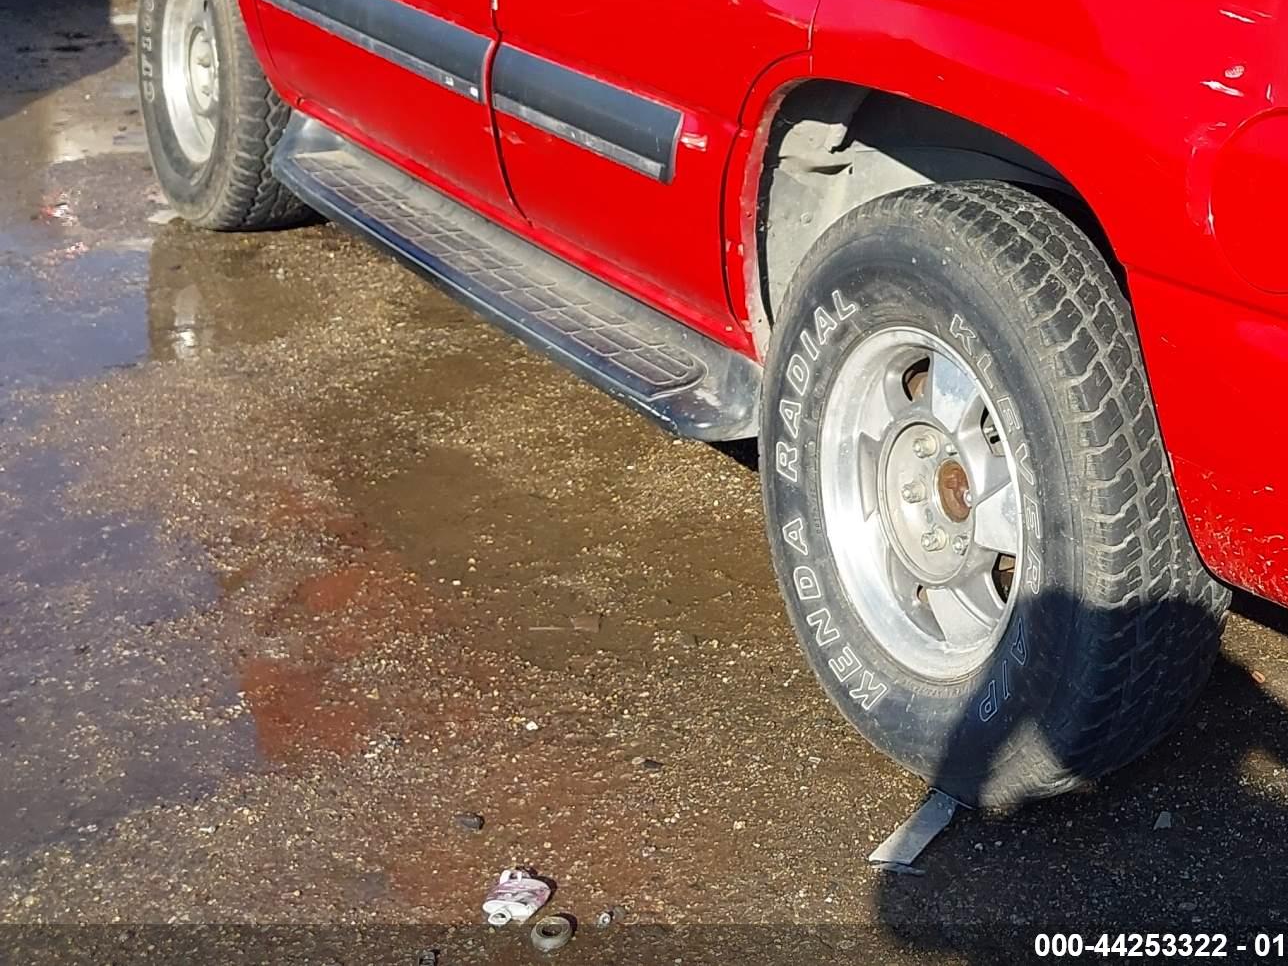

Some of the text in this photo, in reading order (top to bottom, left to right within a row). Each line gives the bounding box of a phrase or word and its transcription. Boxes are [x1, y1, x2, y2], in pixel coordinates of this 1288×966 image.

[776, 290, 888, 710] KENDA RADIAL
[950, 314, 1041, 594] KLEVER
